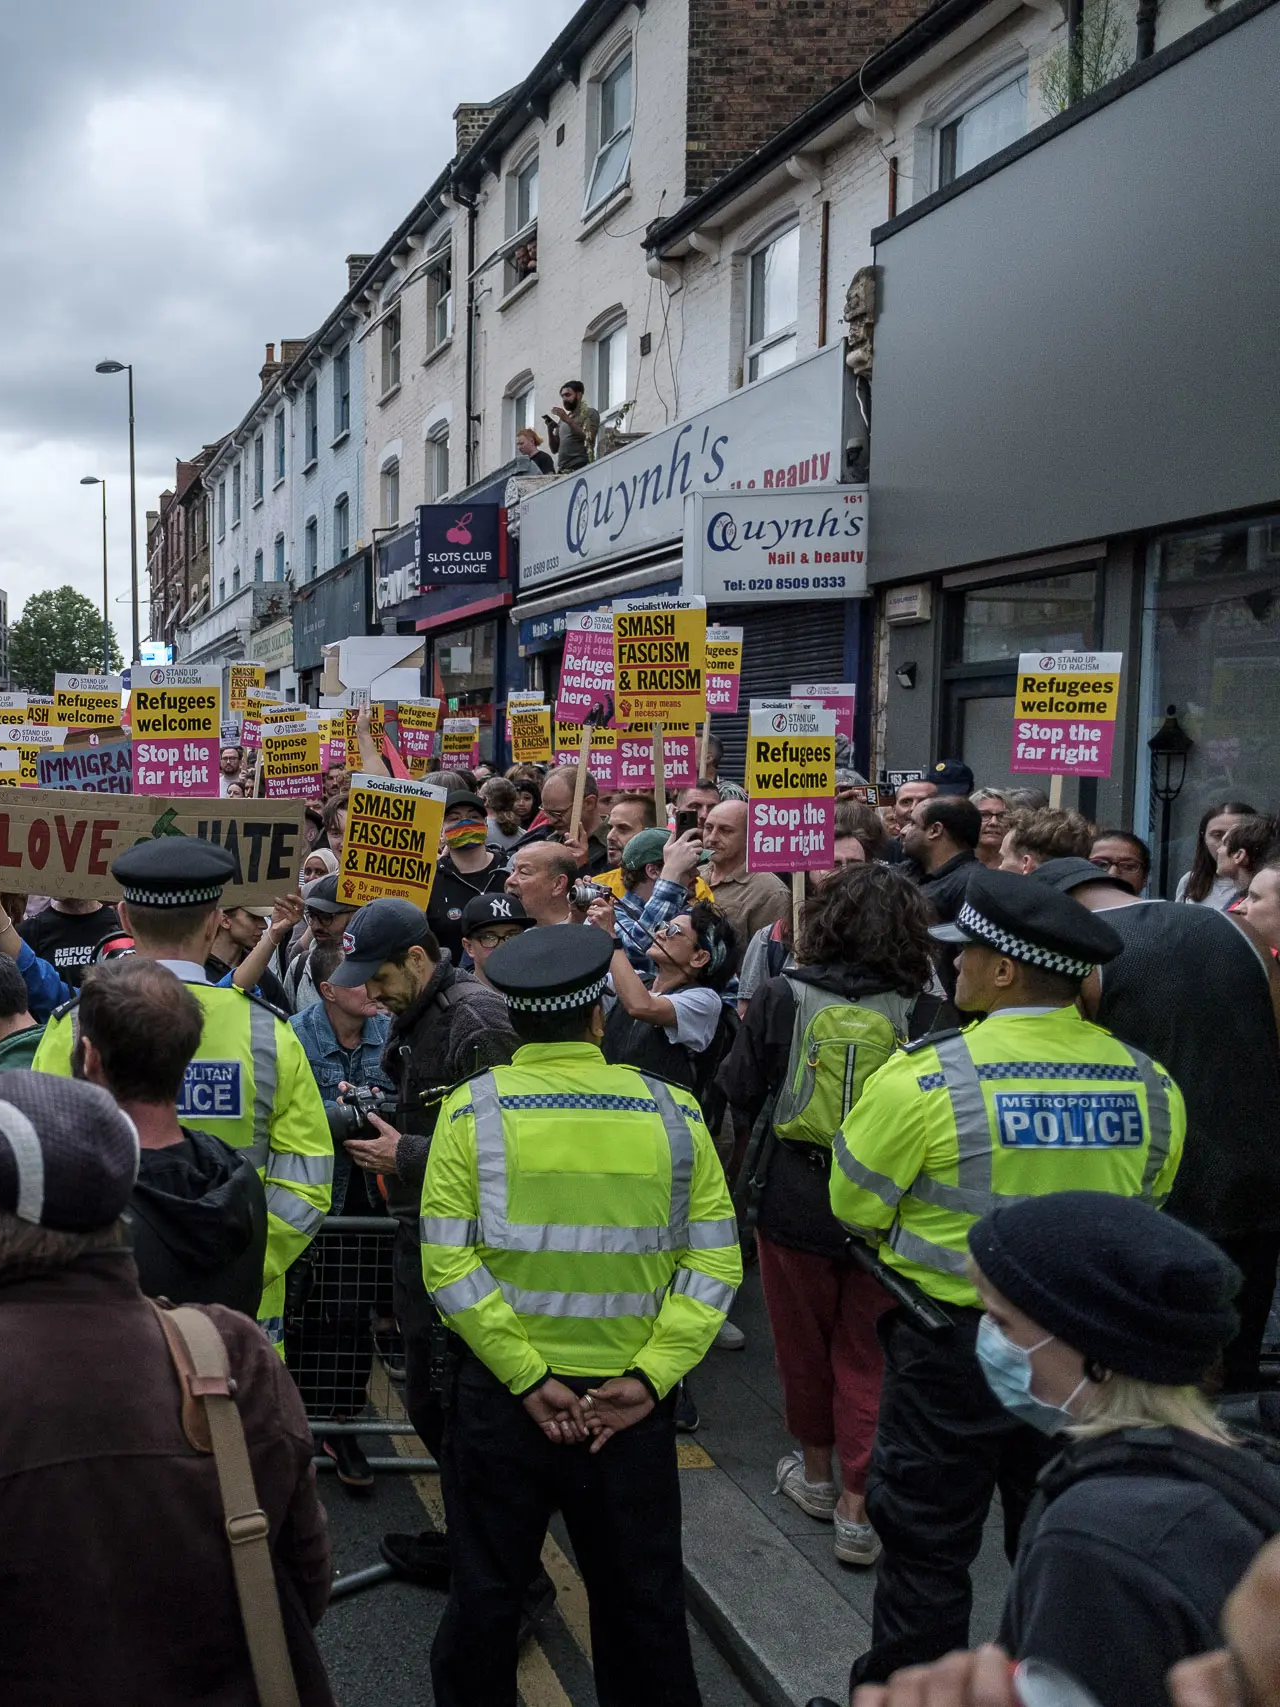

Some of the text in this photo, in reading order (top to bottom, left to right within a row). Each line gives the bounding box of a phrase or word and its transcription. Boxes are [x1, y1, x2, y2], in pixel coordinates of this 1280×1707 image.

[764, 451, 830, 489] Beauty
[566, 424, 728, 558] Quynh's
[843, 495, 863, 504] 161
[707, 507, 864, 553] Quynh's
[428, 551, 492, 562] SLOTS CLUB
[768, 550, 864, 567] Nail & beauty
[442, 564, 486, 574] LOUNGE
[723, 576, 846, 591] Tel: 020 8509 0333
[618, 614, 675, 637] SMASH
[569, 632, 583, 644] Say
[568, 644, 582, 655] Say
[618, 642, 689, 664] FASCISM
[167, 668, 198, 676] STAND UP
[232, 668, 254, 676] SMASH
[619, 669, 701, 690] & RACISM
[232, 678, 260, 688] FASCISM
[712, 678, 732, 689] the
[1022, 677, 1114, 697] Refugees
[58, 694, 118, 710] Refugees
[137, 692, 216, 713] Refugees
[561, 688, 591, 706] here
[634, 700, 682, 709] By any means
[399, 705, 436, 718] Refugees
[1021, 697, 1108, 714] welcome
[58, 710, 115, 724] welcome
[512, 714, 538, 724] SMASH
[635, 710, 670, 718] necessary
[807, 714, 816, 722] UP
[138, 714, 212, 732] welcome
[514, 726, 544, 736] FASCISM
[788, 724, 798, 732] TO
[1018, 722, 1102, 744] Stop the
[265, 738, 307, 750] Oppose
[522, 737, 549, 748] RACISM
[664, 741, 688, 756] the
[138, 744, 209, 766] Stop the
[266, 751, 306, 762] Tommy
[591, 754, 613, 764] the
[756, 742, 831, 766] Refugees
[1016, 743, 1099, 764] far right
[40, 750, 132, 784] IMMIGRA
[268, 762, 318, 776] Robinson
[622, 760, 646, 776] far
[138, 765, 209, 787] far right
[268, 776, 315, 787] Stop fascists
[756, 768, 828, 789] welcome
[890, 774, 902, 786] 163
[353, 793, 416, 822] SMASH
[754, 804, 826, 830] Stop the
[349, 822, 426, 853] FASCISM
[754, 830, 825, 856] far right
[345, 850, 432, 884] & RACISM
[358, 882, 368, 892] By
[372, 886, 382, 894] any
[385, 888, 409, 898] means
[490, 898, 512, 916] NY
[1002, 1097, 1136, 1108] METROPOLITAN
[1004, 1110, 1140, 1142] POLICE
